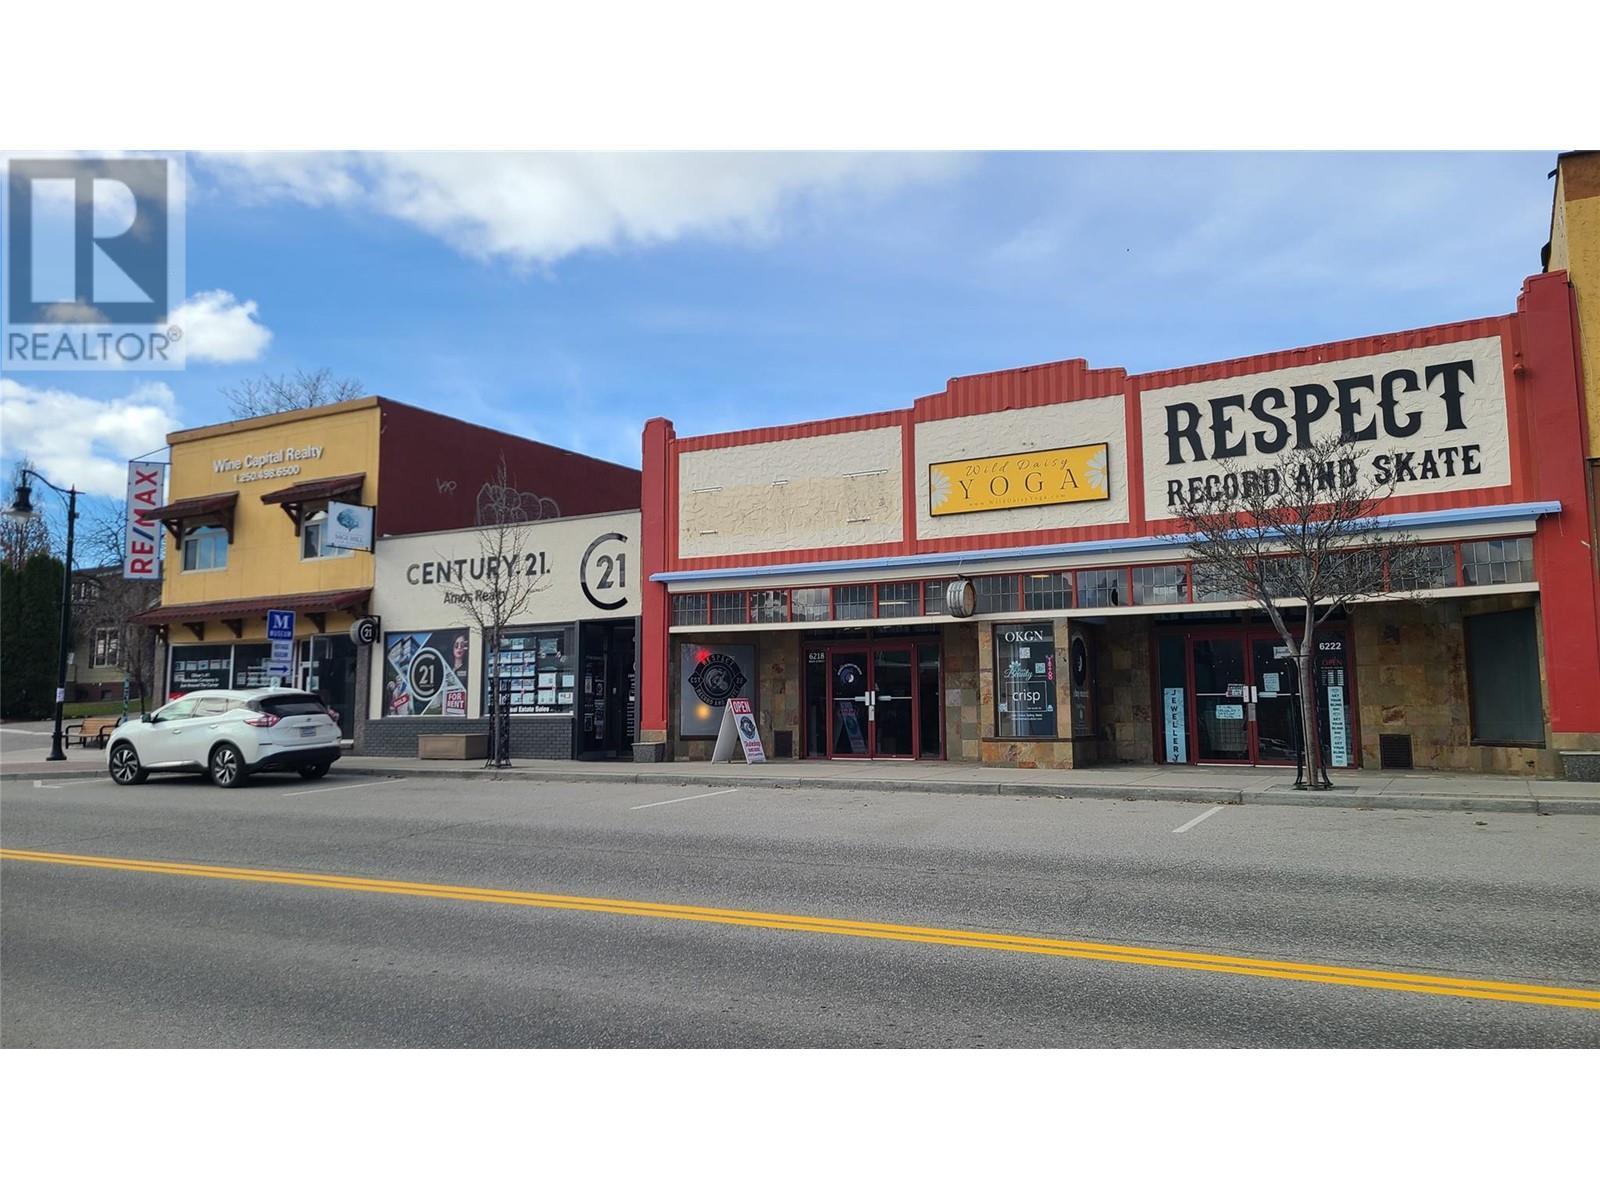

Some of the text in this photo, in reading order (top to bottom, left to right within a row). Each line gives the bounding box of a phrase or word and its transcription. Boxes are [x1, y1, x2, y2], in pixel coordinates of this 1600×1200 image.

[1164, 359, 1475, 465] RESPECT
[213, 445, 323, 473] Wine Capital Realty
[965, 457, 1069, 477] Wild Daisy
[1167, 444, 1481, 507] RECORD AND SKATE
[959, 468, 1079, 500] YOGA
[130, 470, 159, 574] RE/MAX
[475, 589, 506, 603] Reaty
[273, 615, 290, 629] M
[1004, 630, 1044, 642] OKGN
[1319, 642, 1342, 651] 6222
[808, 652, 825, 660] 6218
[419, 664, 435, 685] 21
[447, 692, 463, 701] FOR
[1012, 688, 1041, 704] crisp
[447, 701, 465, 709] RENT
[732, 700, 752, 713] OPEN
[1170, 689, 1180, 762] JEWELLERY
